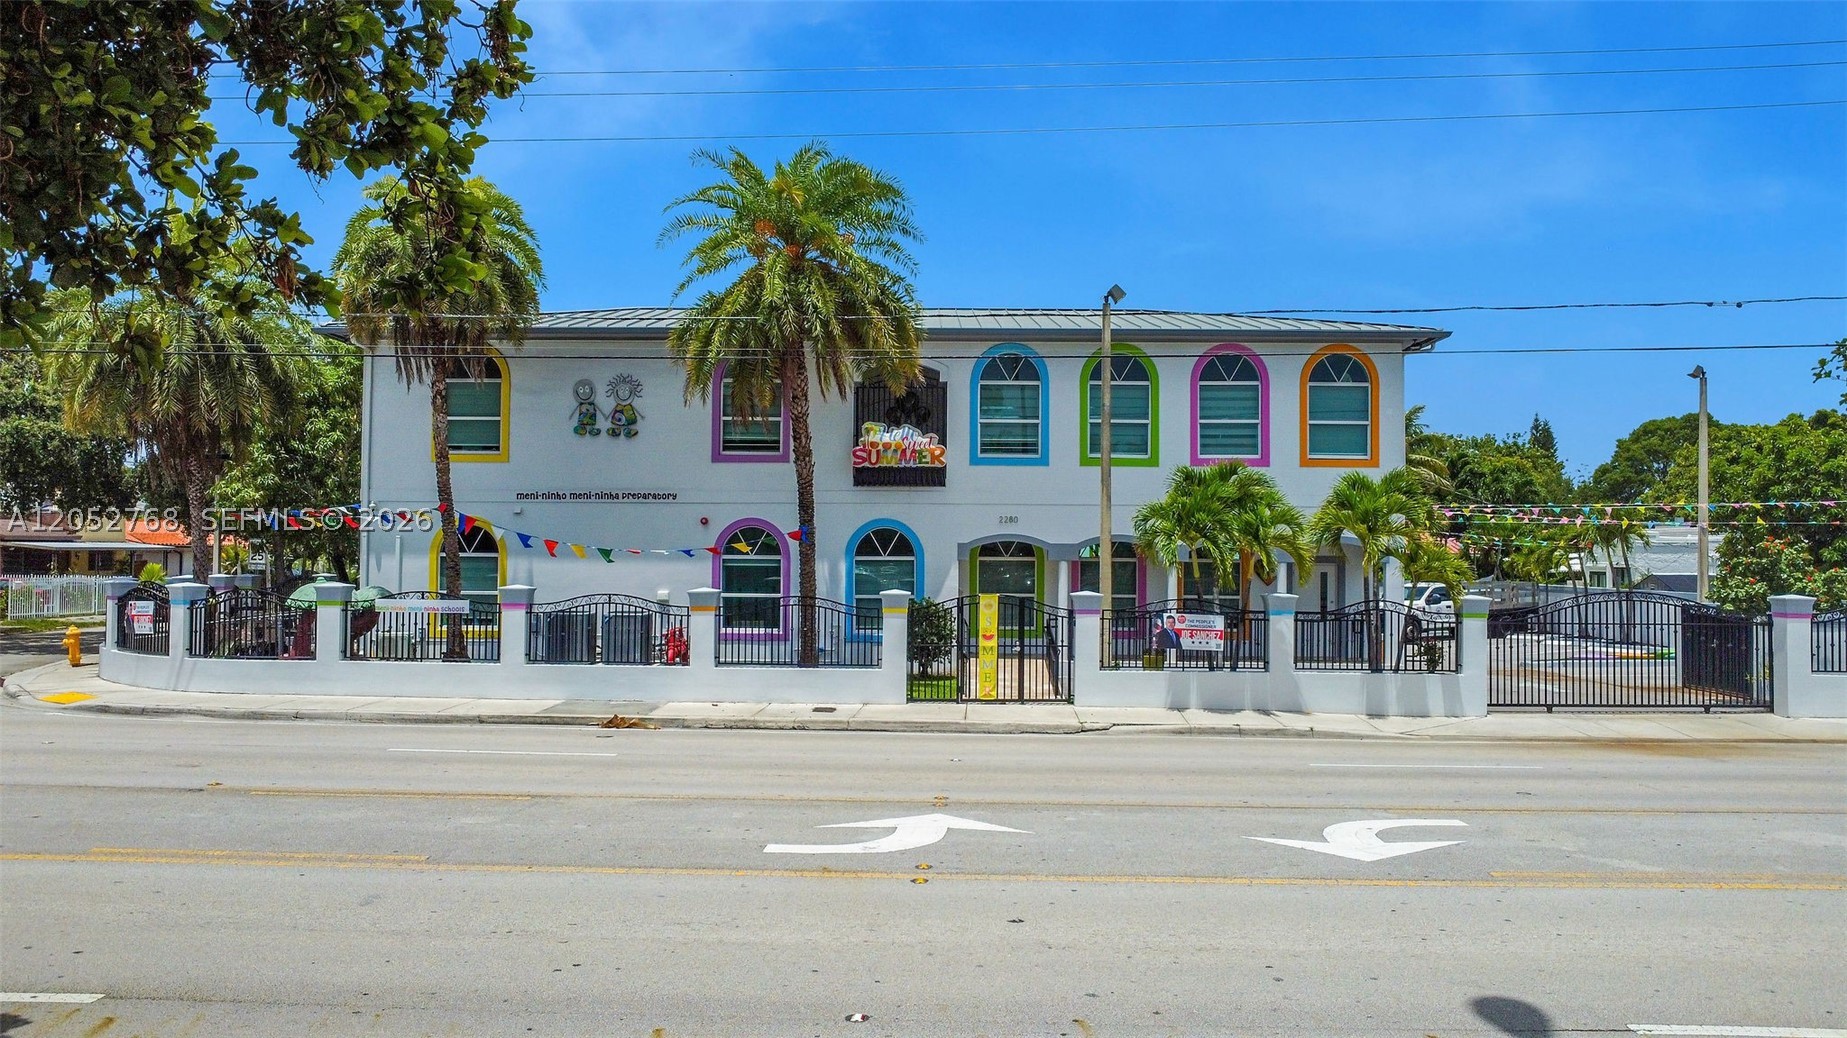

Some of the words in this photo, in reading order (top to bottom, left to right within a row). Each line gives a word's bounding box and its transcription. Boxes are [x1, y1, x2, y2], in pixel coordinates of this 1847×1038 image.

[852, 446, 946, 465] SUMMER
[516, 491, 567, 500] meni-ninho
[569, 491, 620, 500] meni-ninha
[621, 491, 678, 501] preparatory
[250, 552, 264, 561] 25
[1181, 630, 1191, 640] JOE
[1192, 630, 1221, 640] SANCHEZ
